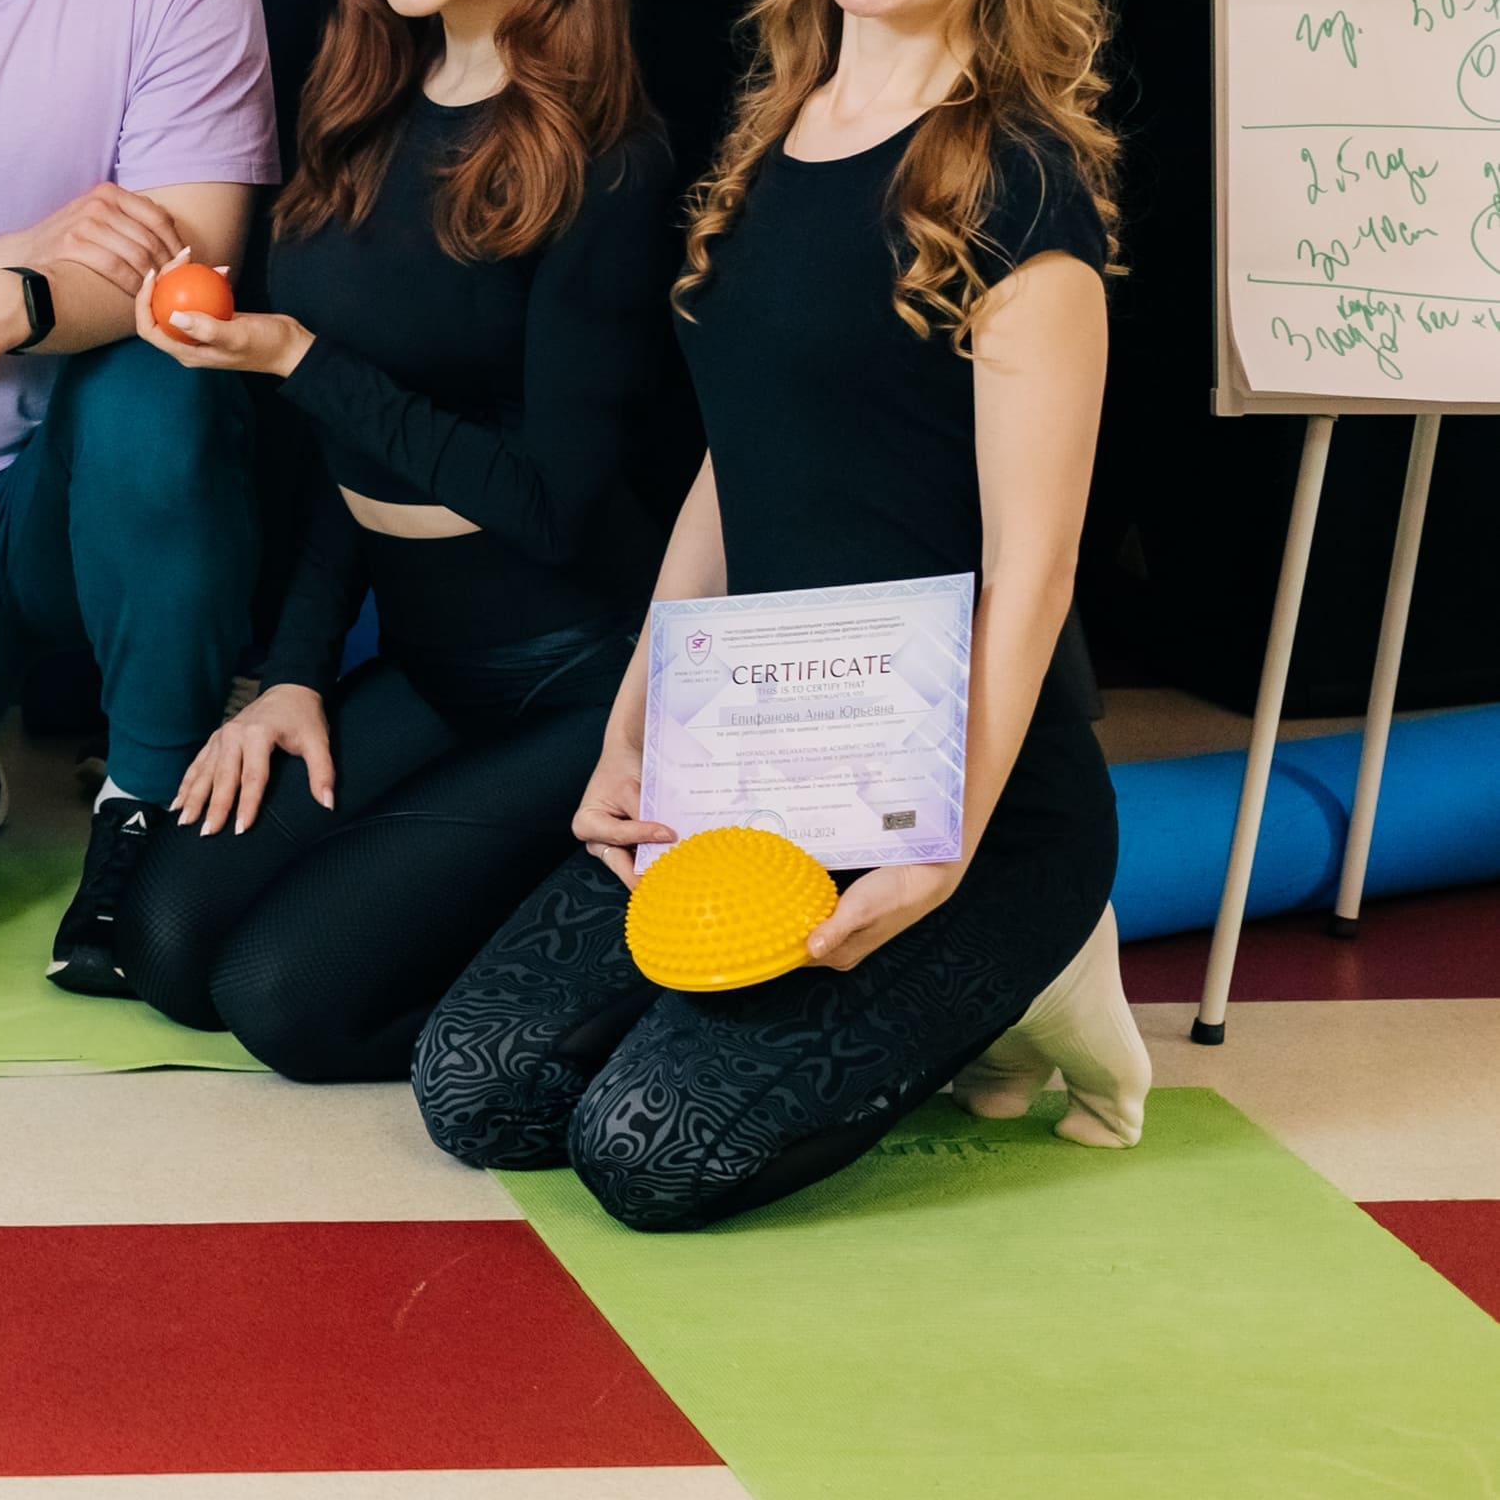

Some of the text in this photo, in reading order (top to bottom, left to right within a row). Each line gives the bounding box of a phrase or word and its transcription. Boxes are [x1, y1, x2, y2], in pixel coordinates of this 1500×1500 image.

[730, 653, 892, 686] CERTIFICATE
[780, 685, 789, 694] IS
[791, 684, 804, 693] TO
[805, 681, 840, 692] CERTIFY
[843, 679, 865, 690] THAT
[730, 700, 895, 727] Епифанова Анна Юрьевна
